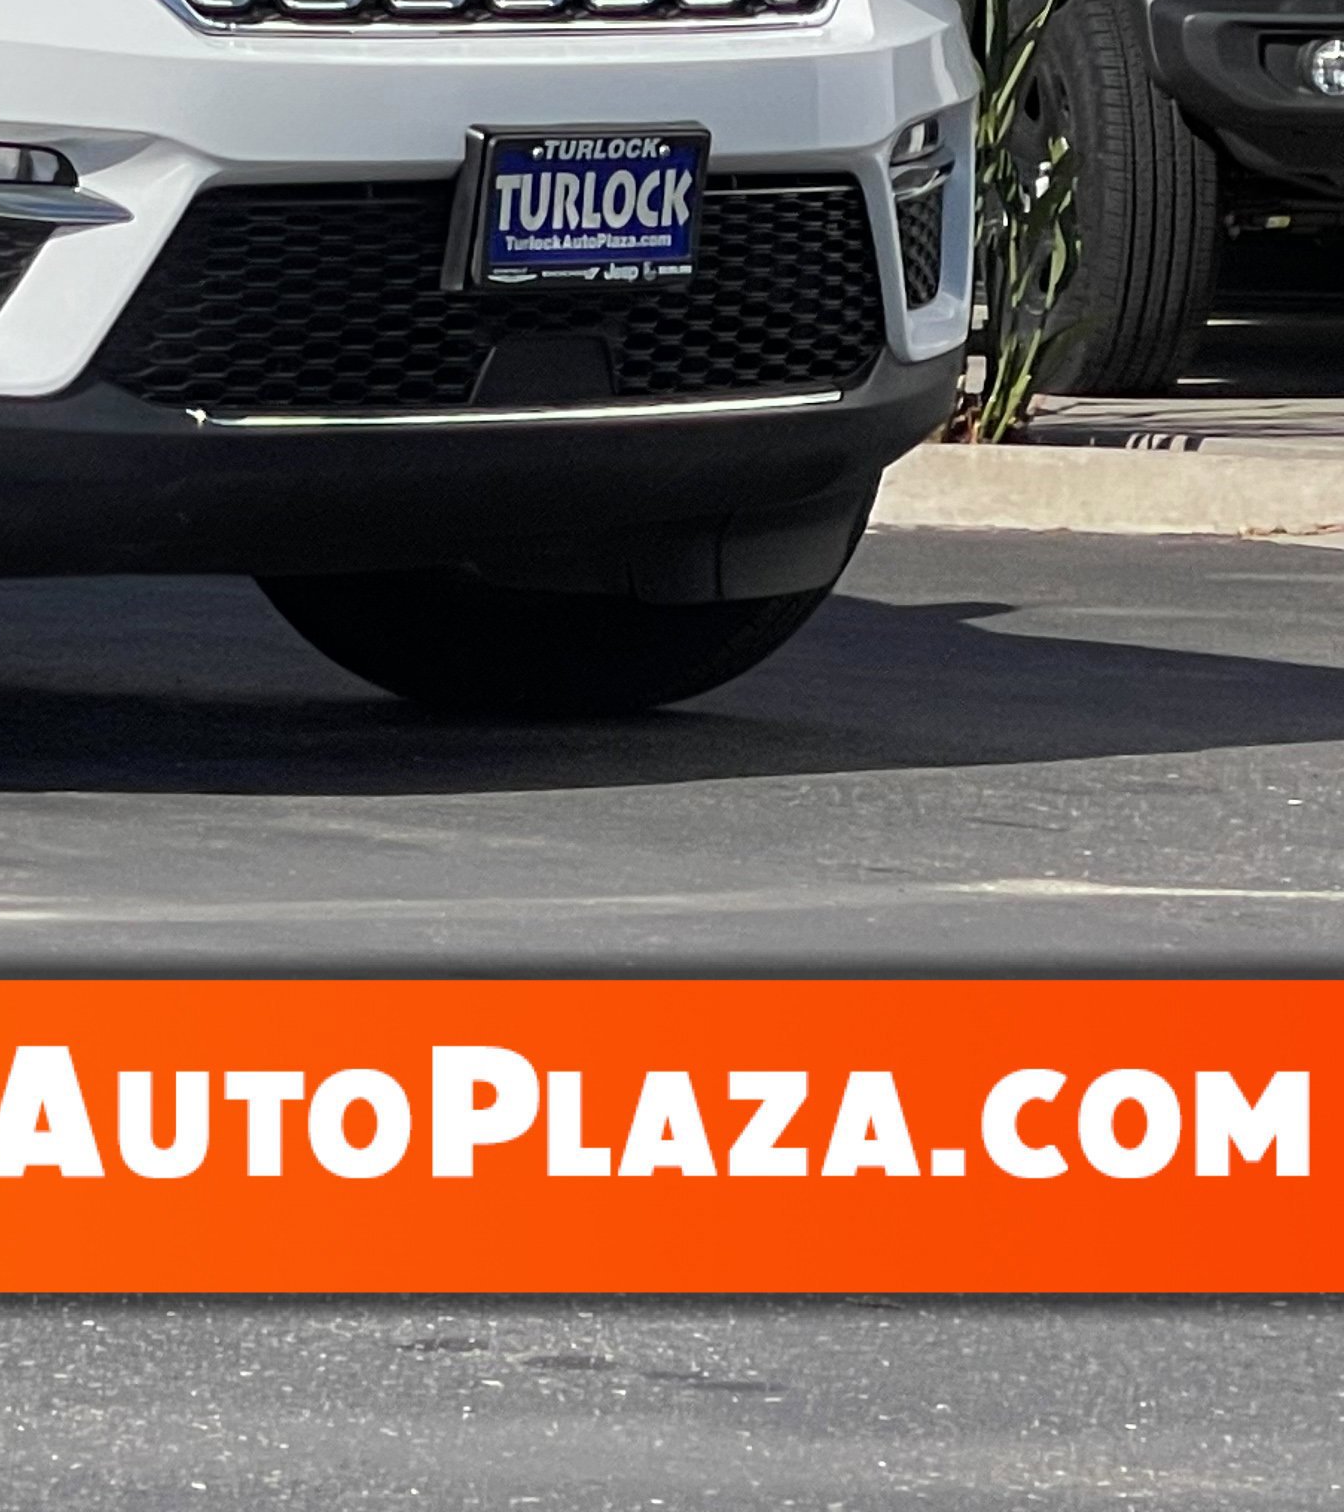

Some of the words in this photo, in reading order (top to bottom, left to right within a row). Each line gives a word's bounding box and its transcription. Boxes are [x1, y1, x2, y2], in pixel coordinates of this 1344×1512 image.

[543, 138, 661, 160] TURLOCK
[495, 168, 693, 231] TURLOCK
[506, 233, 672, 251] TurlockAutoPlaza.com
